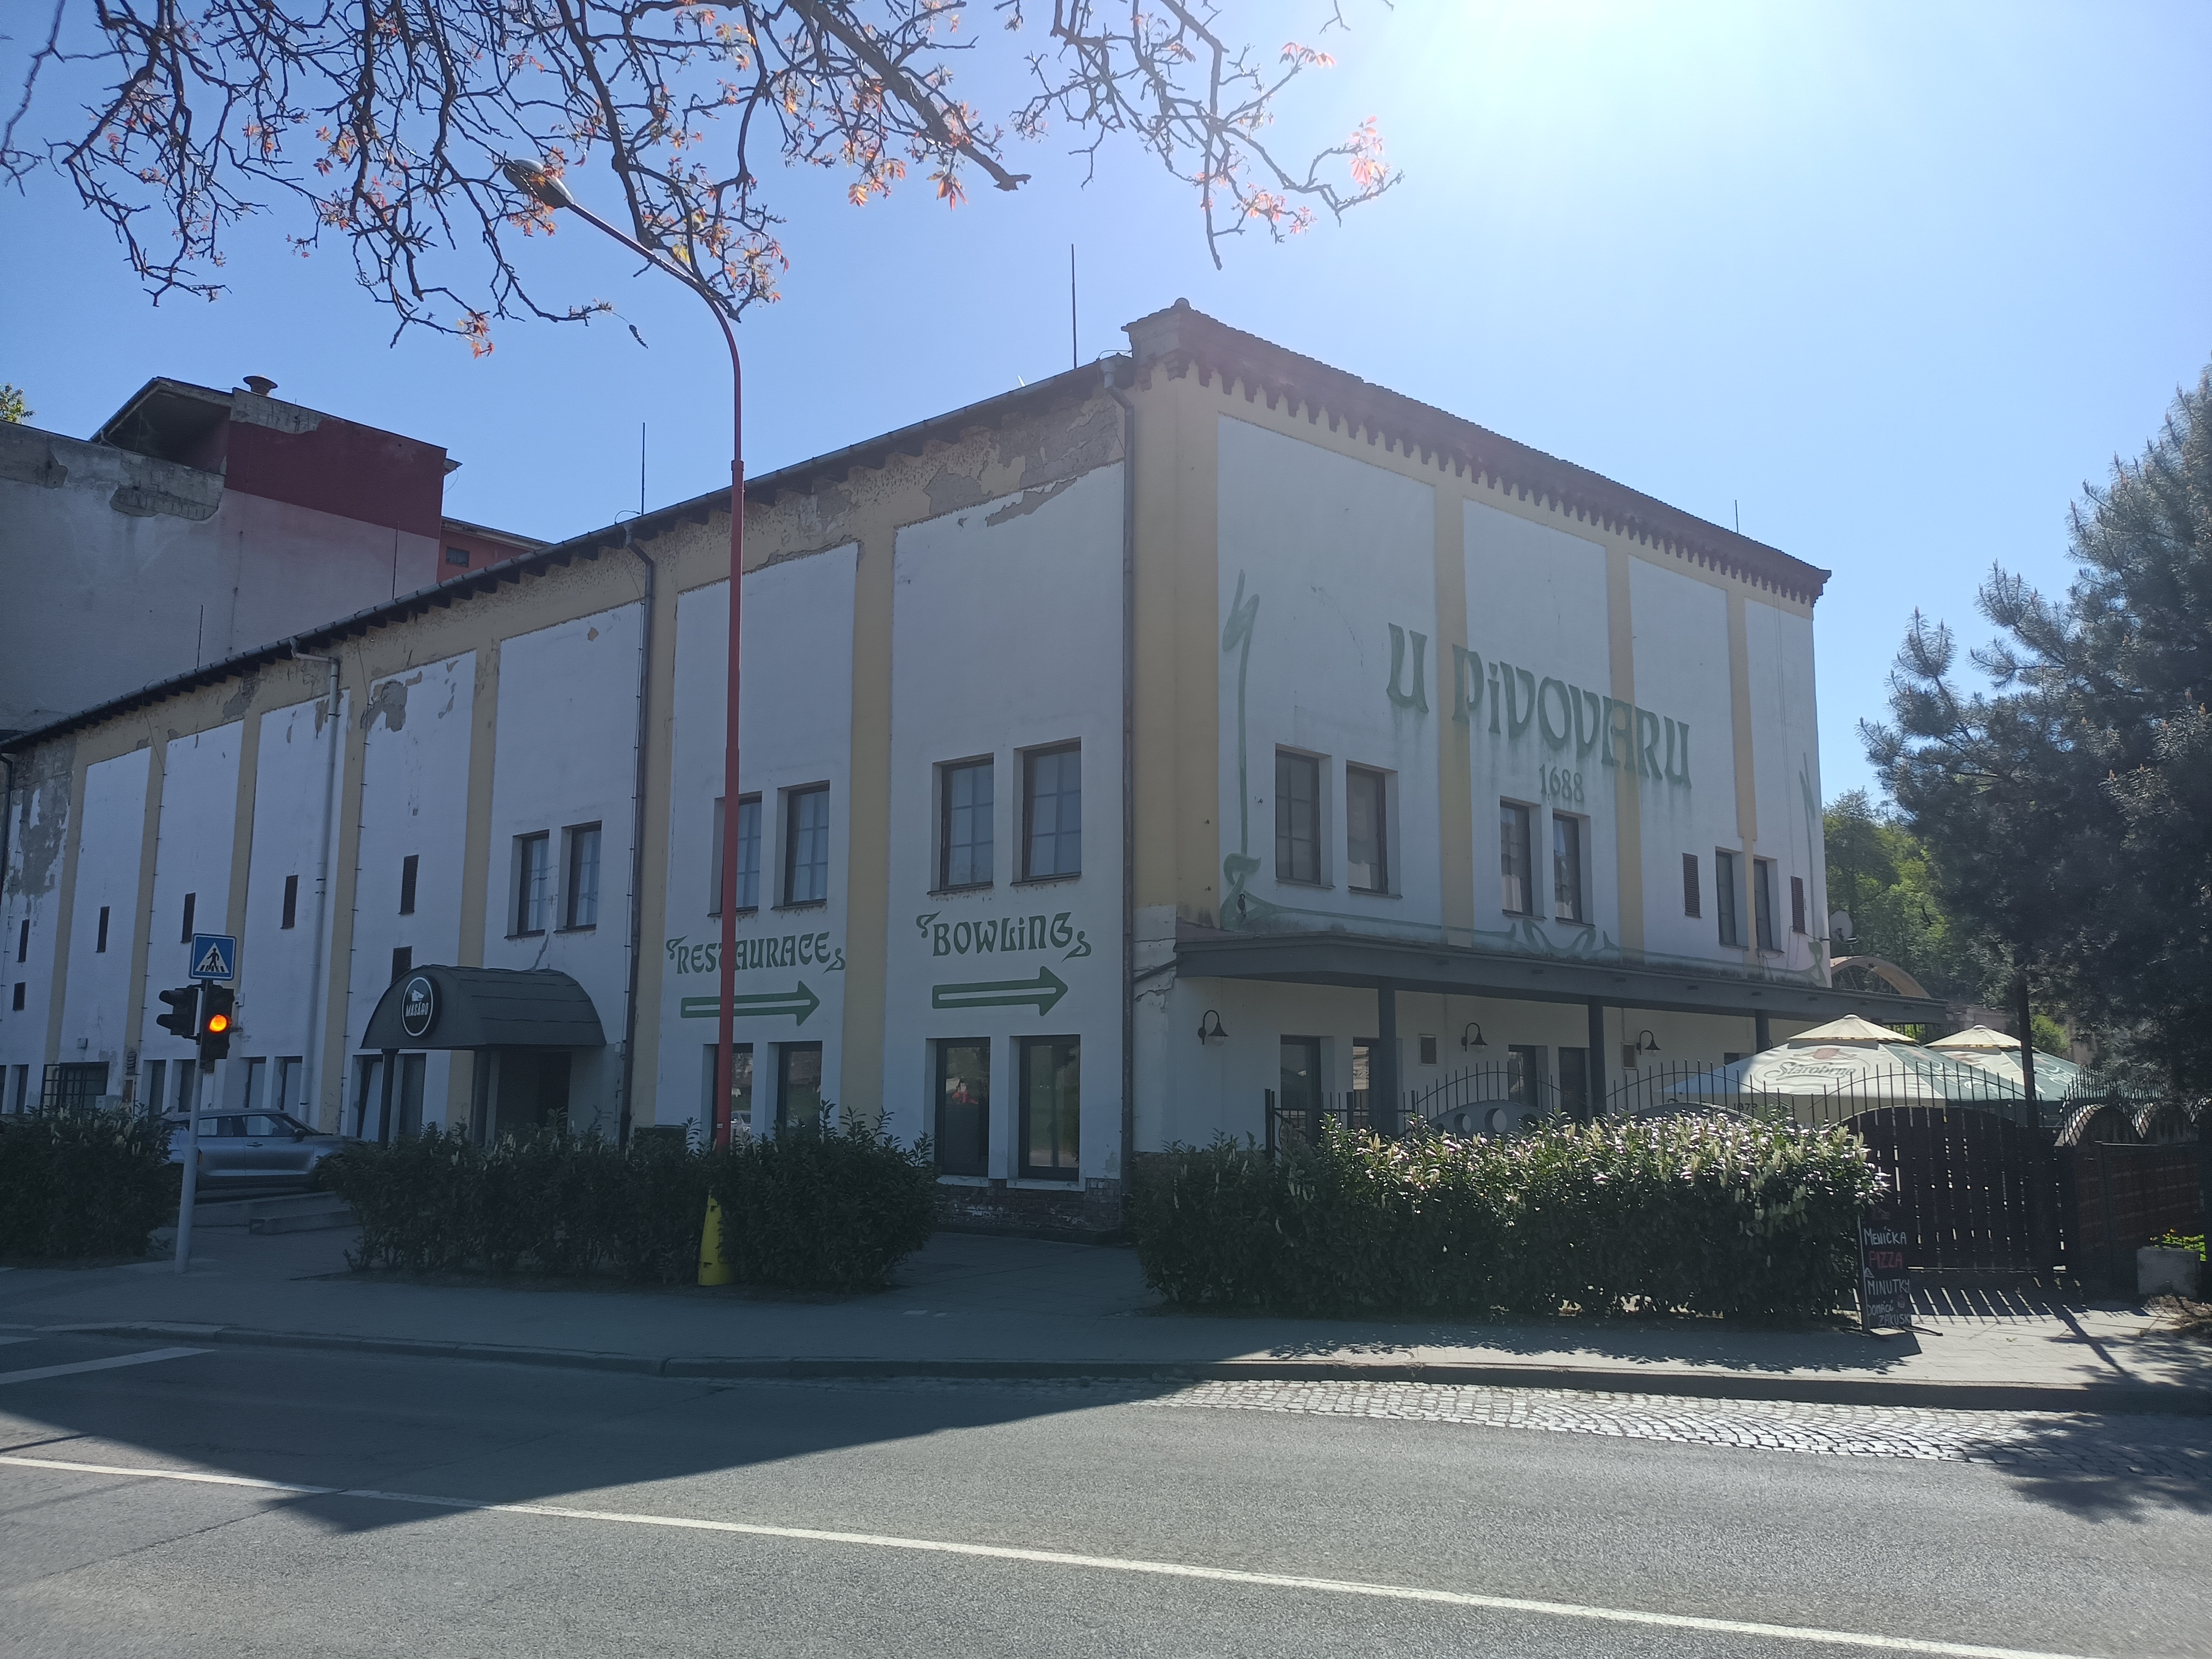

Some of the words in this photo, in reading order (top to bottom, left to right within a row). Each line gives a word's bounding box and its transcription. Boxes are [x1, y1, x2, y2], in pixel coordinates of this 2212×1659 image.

[1386, 622, 1429, 713] U
[1539, 764, 1584, 802] 1688
[677, 931, 830, 974] RESAURACE
[1869, 1251, 1902, 1269] PIZZA
[1867, 1279, 1910, 1295] MINUTKY
